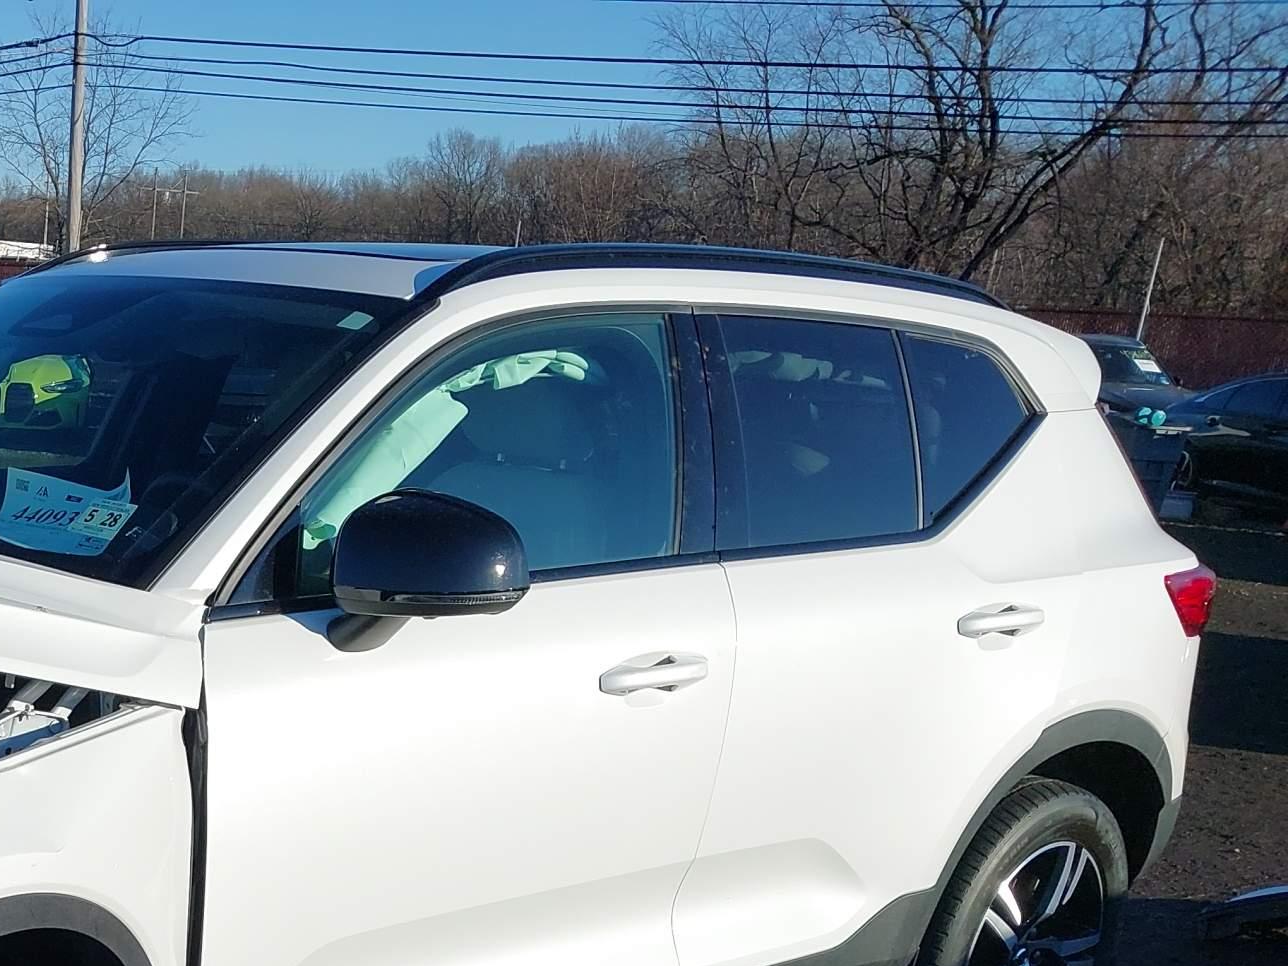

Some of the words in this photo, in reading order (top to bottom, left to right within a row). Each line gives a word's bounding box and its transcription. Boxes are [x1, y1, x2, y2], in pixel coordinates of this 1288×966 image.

[12, 505, 81, 526] 44093
[84, 509, 99, 523] 5
[100, 512, 123, 528] 28
